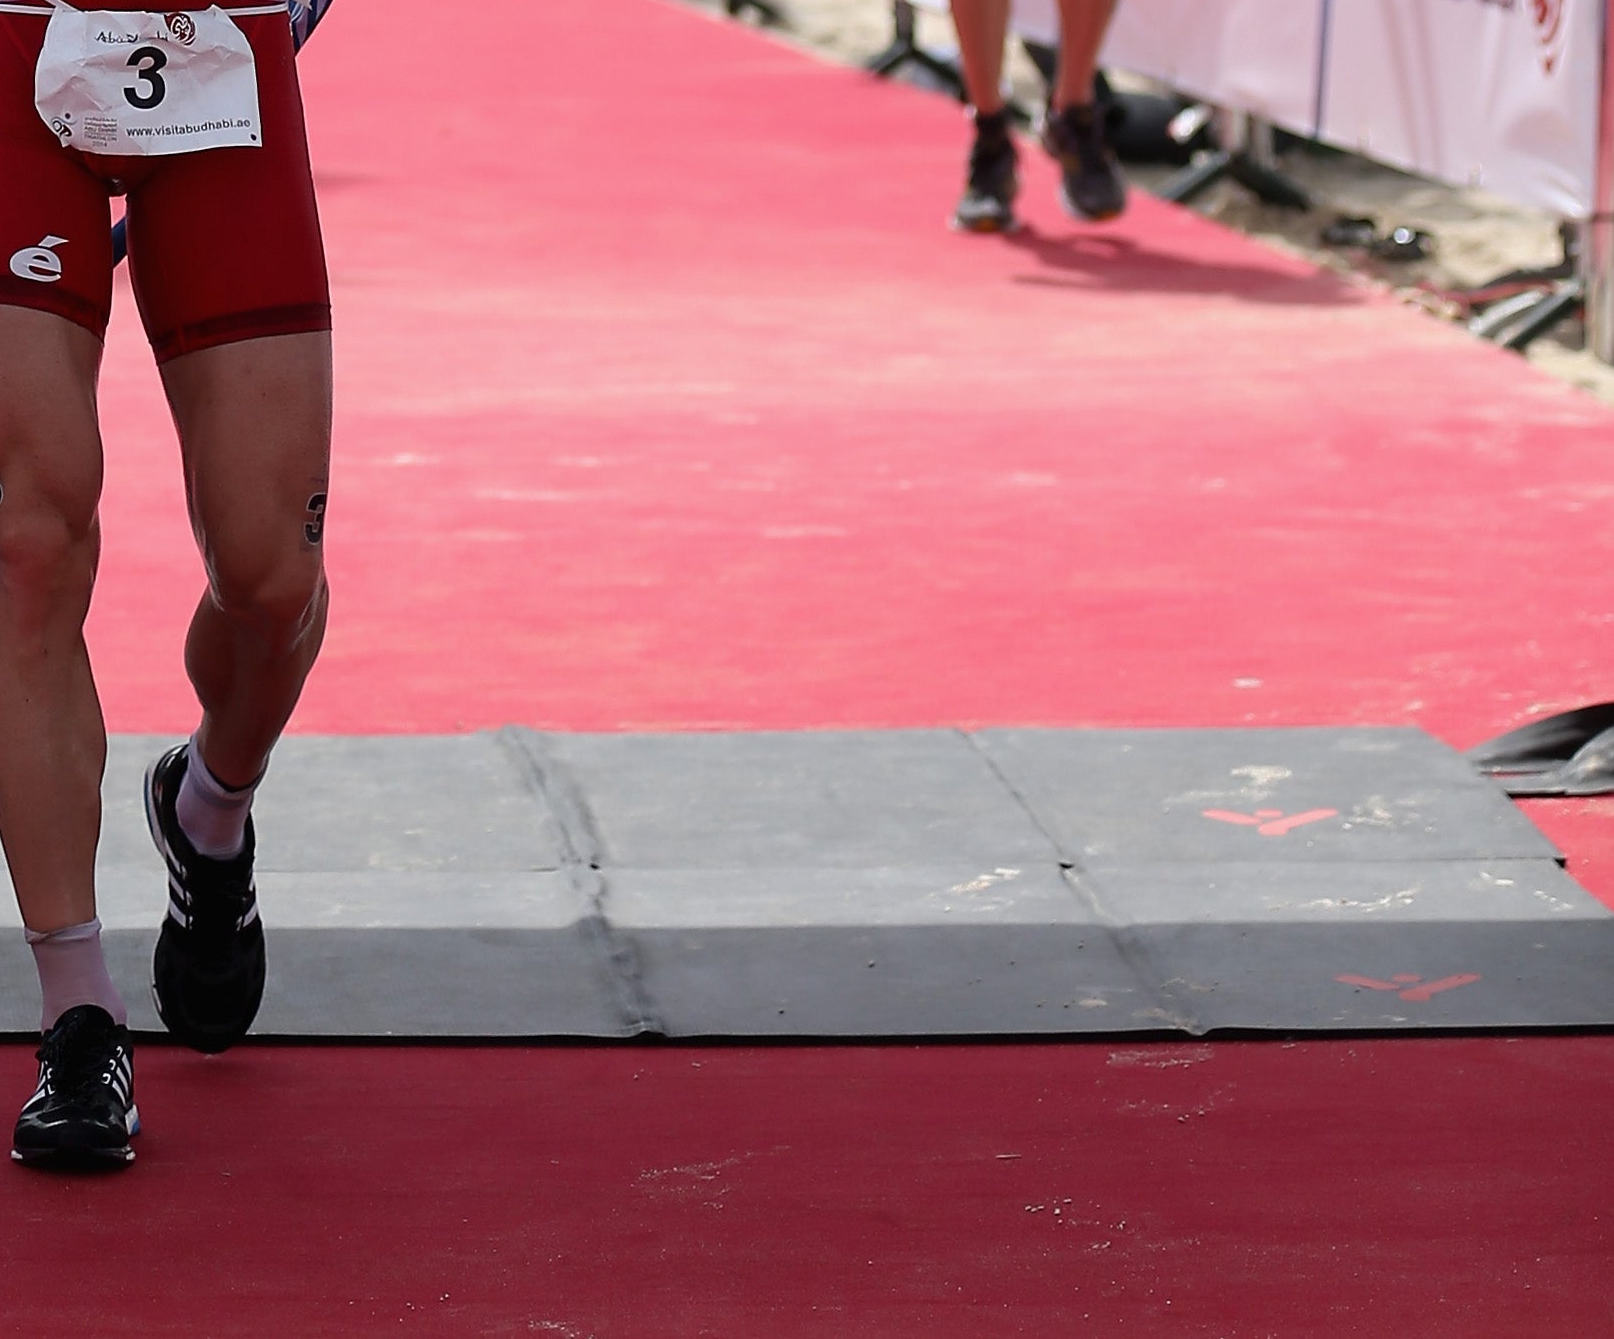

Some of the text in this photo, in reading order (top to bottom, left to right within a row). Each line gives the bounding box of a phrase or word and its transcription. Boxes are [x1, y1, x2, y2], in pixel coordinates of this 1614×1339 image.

[124, 46, 167, 110] 3
[126, 118, 251, 137] www.visitabudhabi.ae
[305, 492, 327, 545] 3
